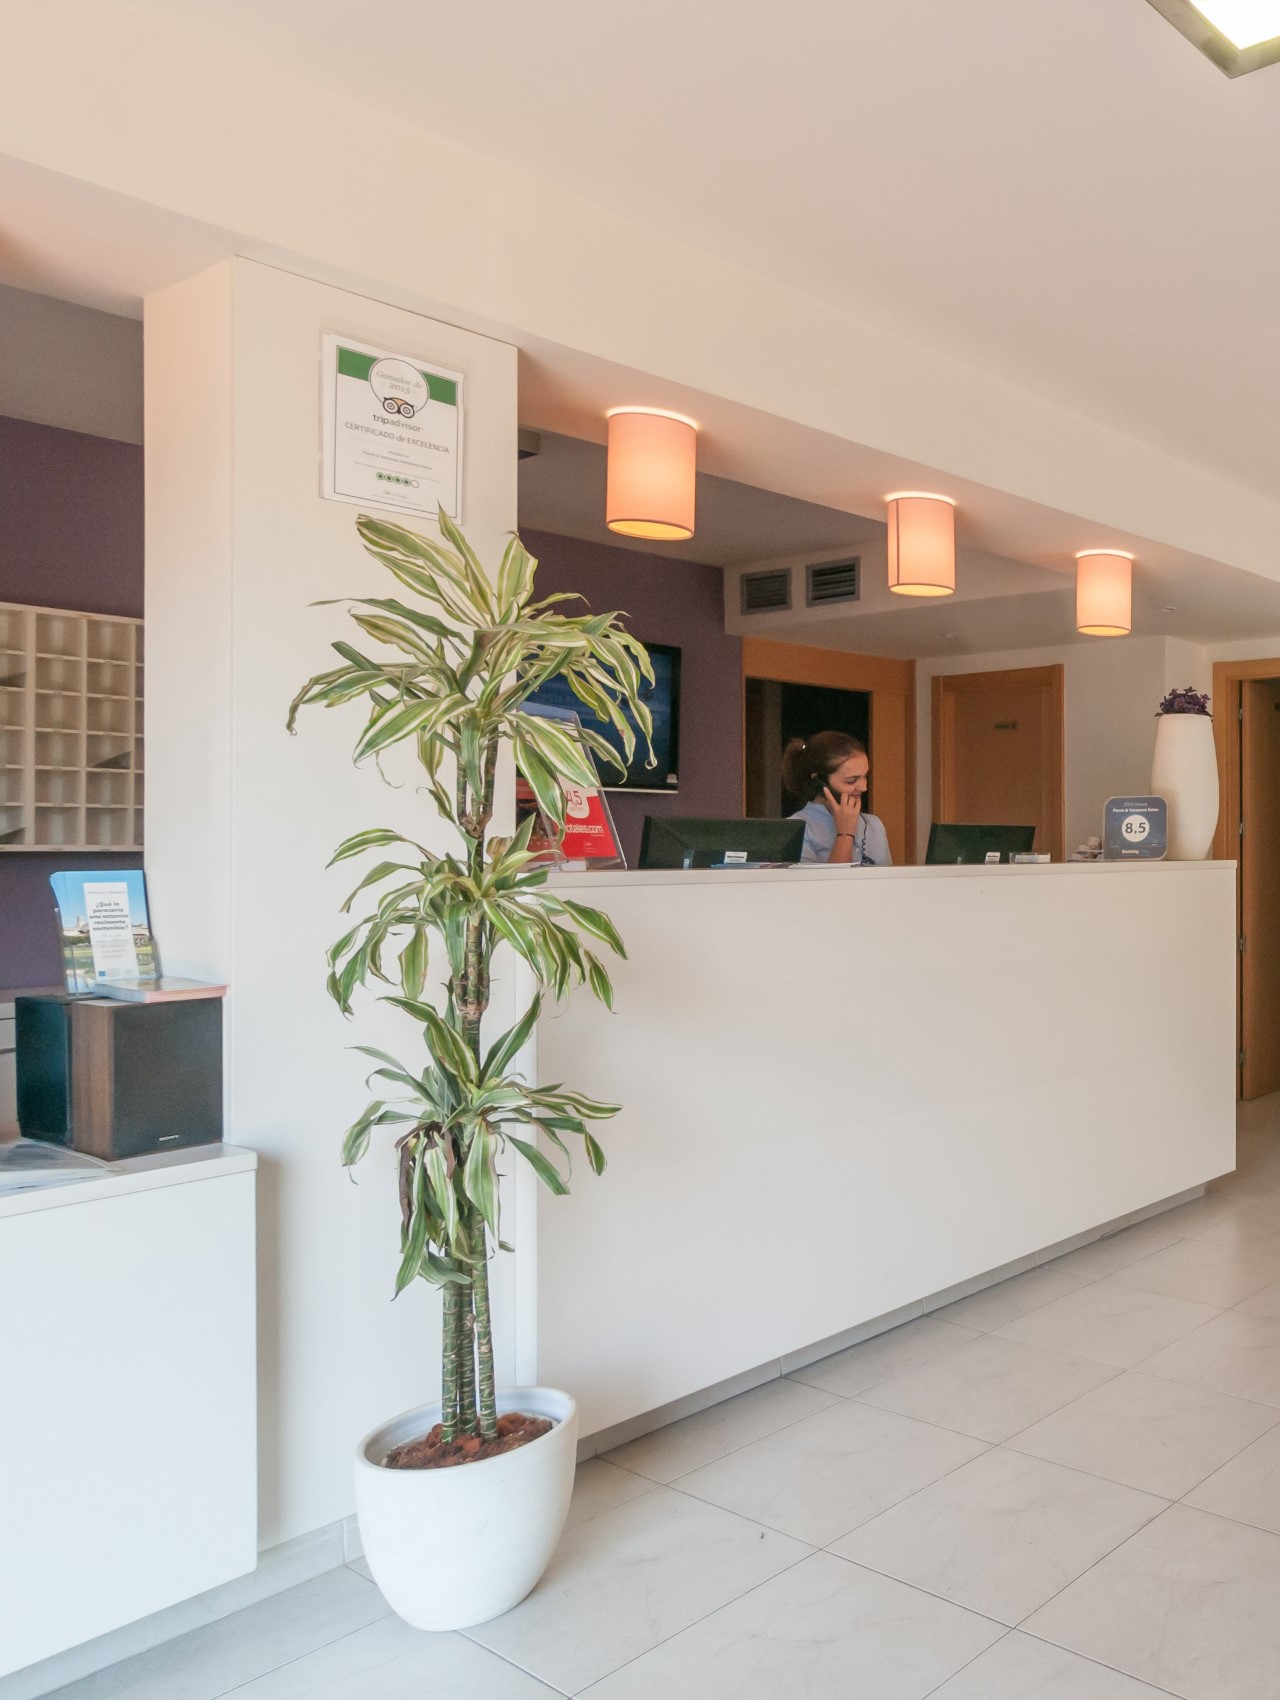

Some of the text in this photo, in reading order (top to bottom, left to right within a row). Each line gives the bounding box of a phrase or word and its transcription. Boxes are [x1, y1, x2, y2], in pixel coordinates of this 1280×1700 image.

[389, 382, 411, 395] 2015
[373, 414, 422, 433] tripadvisor
[344, 421, 450, 454] CERTIFICADO de EXCELENCIA
